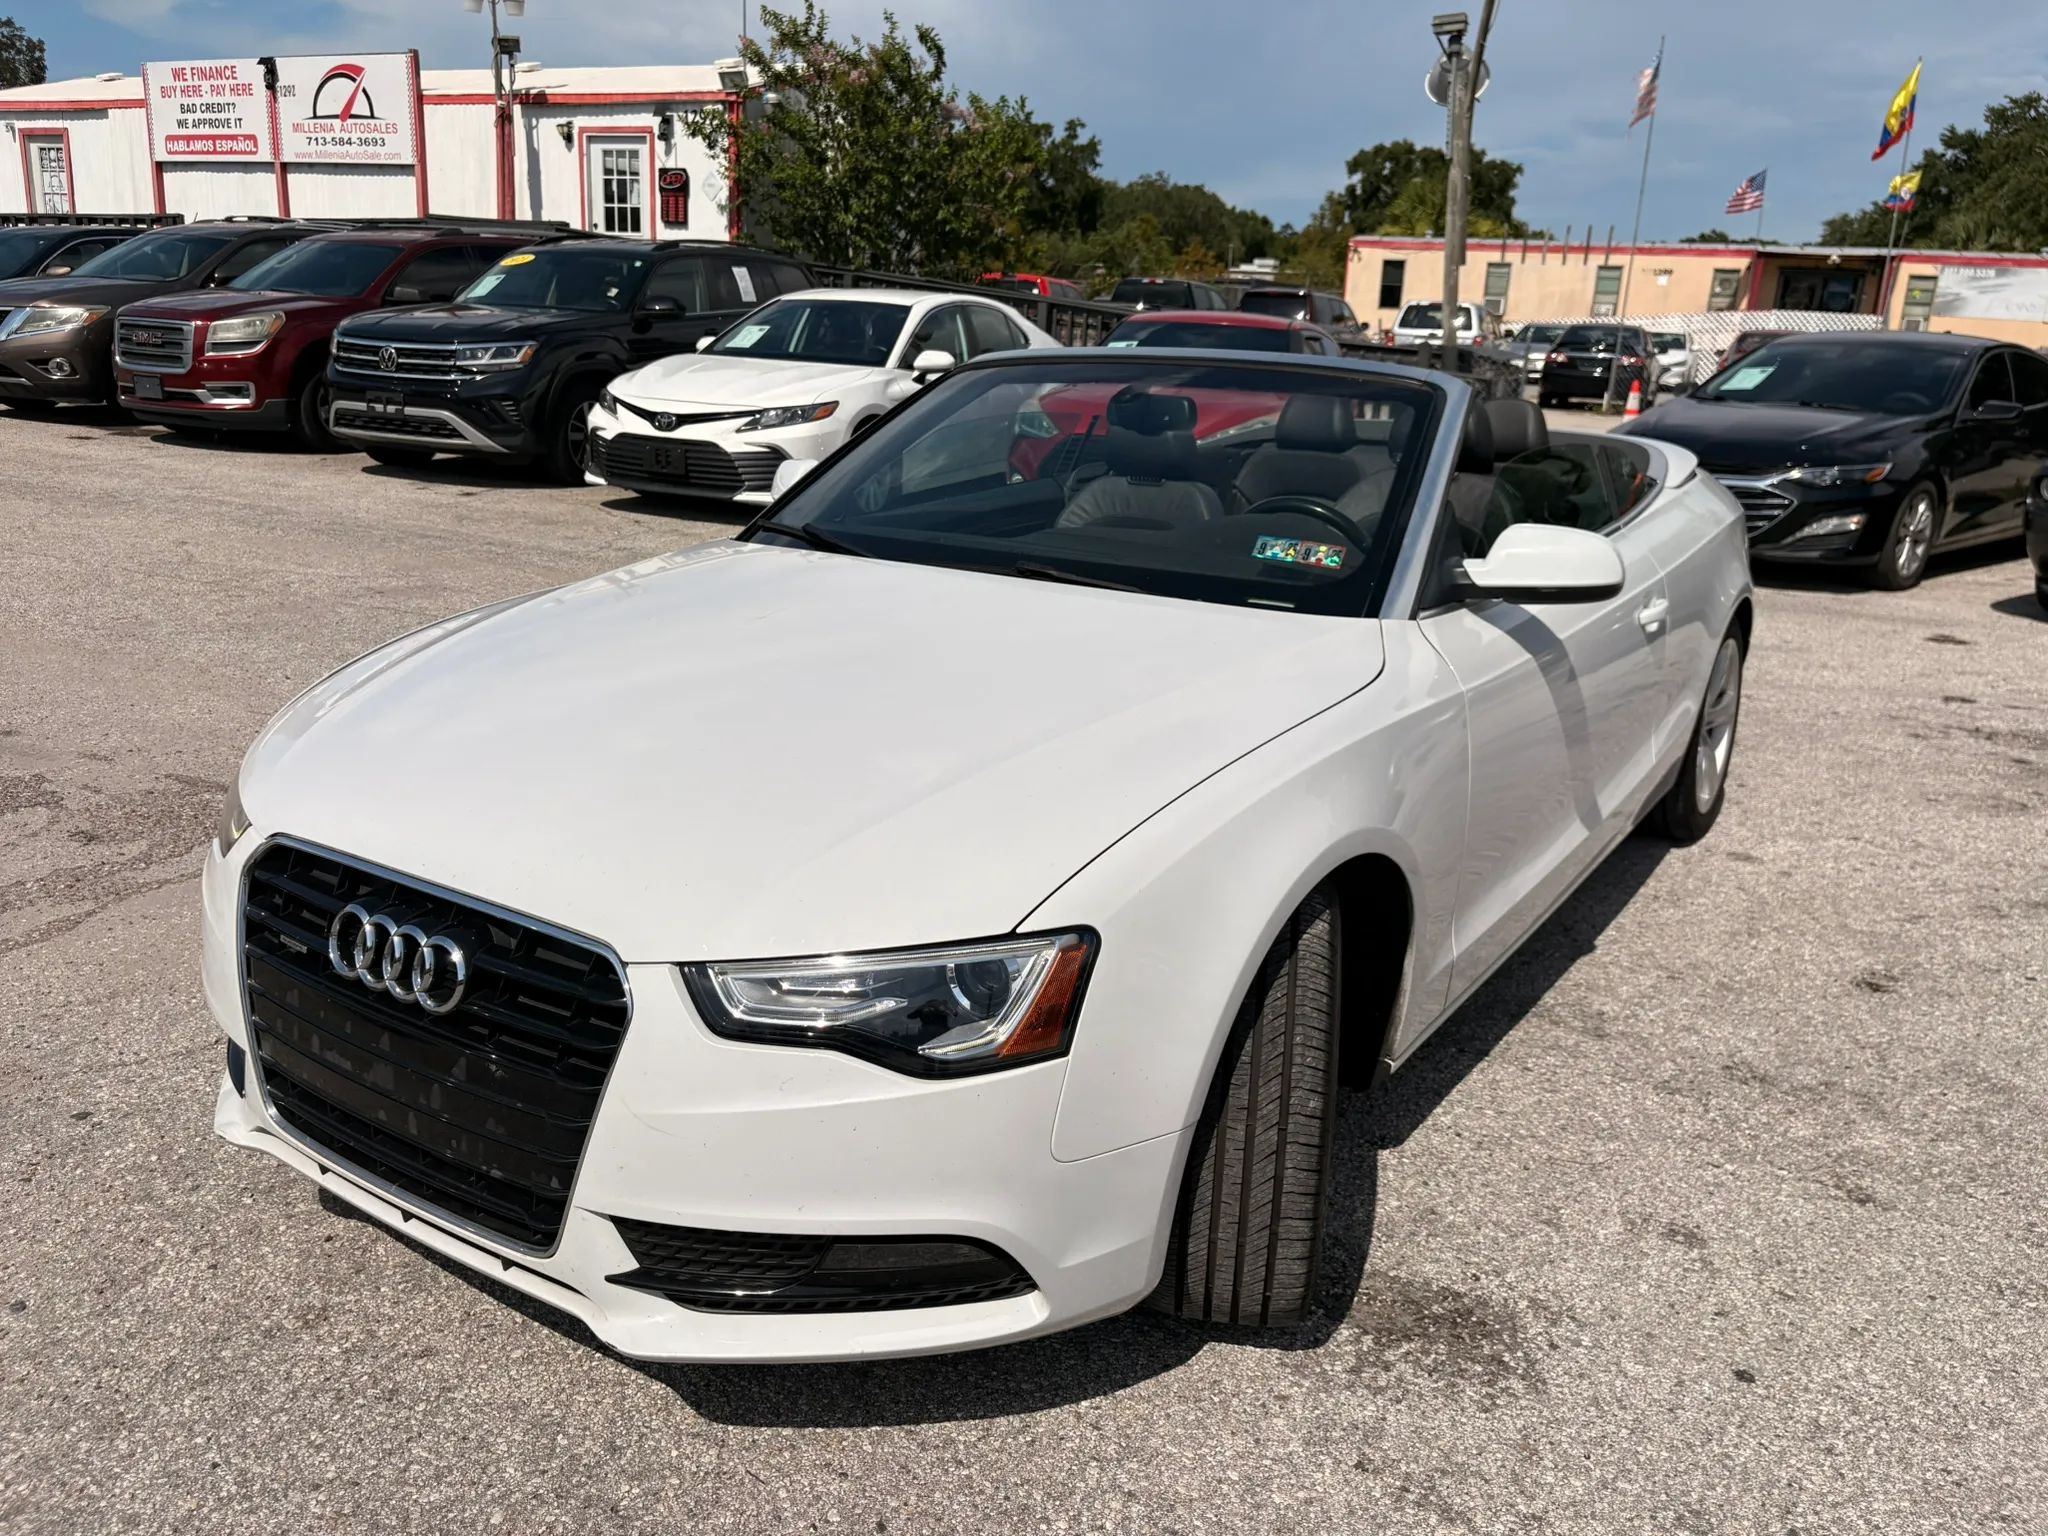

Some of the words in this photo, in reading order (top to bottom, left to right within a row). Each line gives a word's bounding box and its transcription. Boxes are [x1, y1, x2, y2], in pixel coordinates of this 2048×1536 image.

[171, 67, 188, 82] WE
[190, 65, 238, 81] FINANCE
[160, 85, 178, 98] BUY
[180, 84, 204, 98] HERE
[210, 83, 227, 97] PAY
[229, 83, 254, 96] HERE
[180, 103, 197, 114] BAD
[199, 102, 237, 114] CREDIT?
[176, 118, 189, 129] WE
[191, 118, 232, 129] APPROVE
[234, 117, 243, 129] IT
[292, 123, 335, 133] MILLENIA
[340, 123, 398, 134] AUTOSALES
[166, 139, 214, 152] HABLAMOS
[216, 136, 257, 152] ESPAÑOL
[306, 136, 386, 147] 713-584-3693
[294, 150, 402, 161] www.MilleniaAutoSale.com
